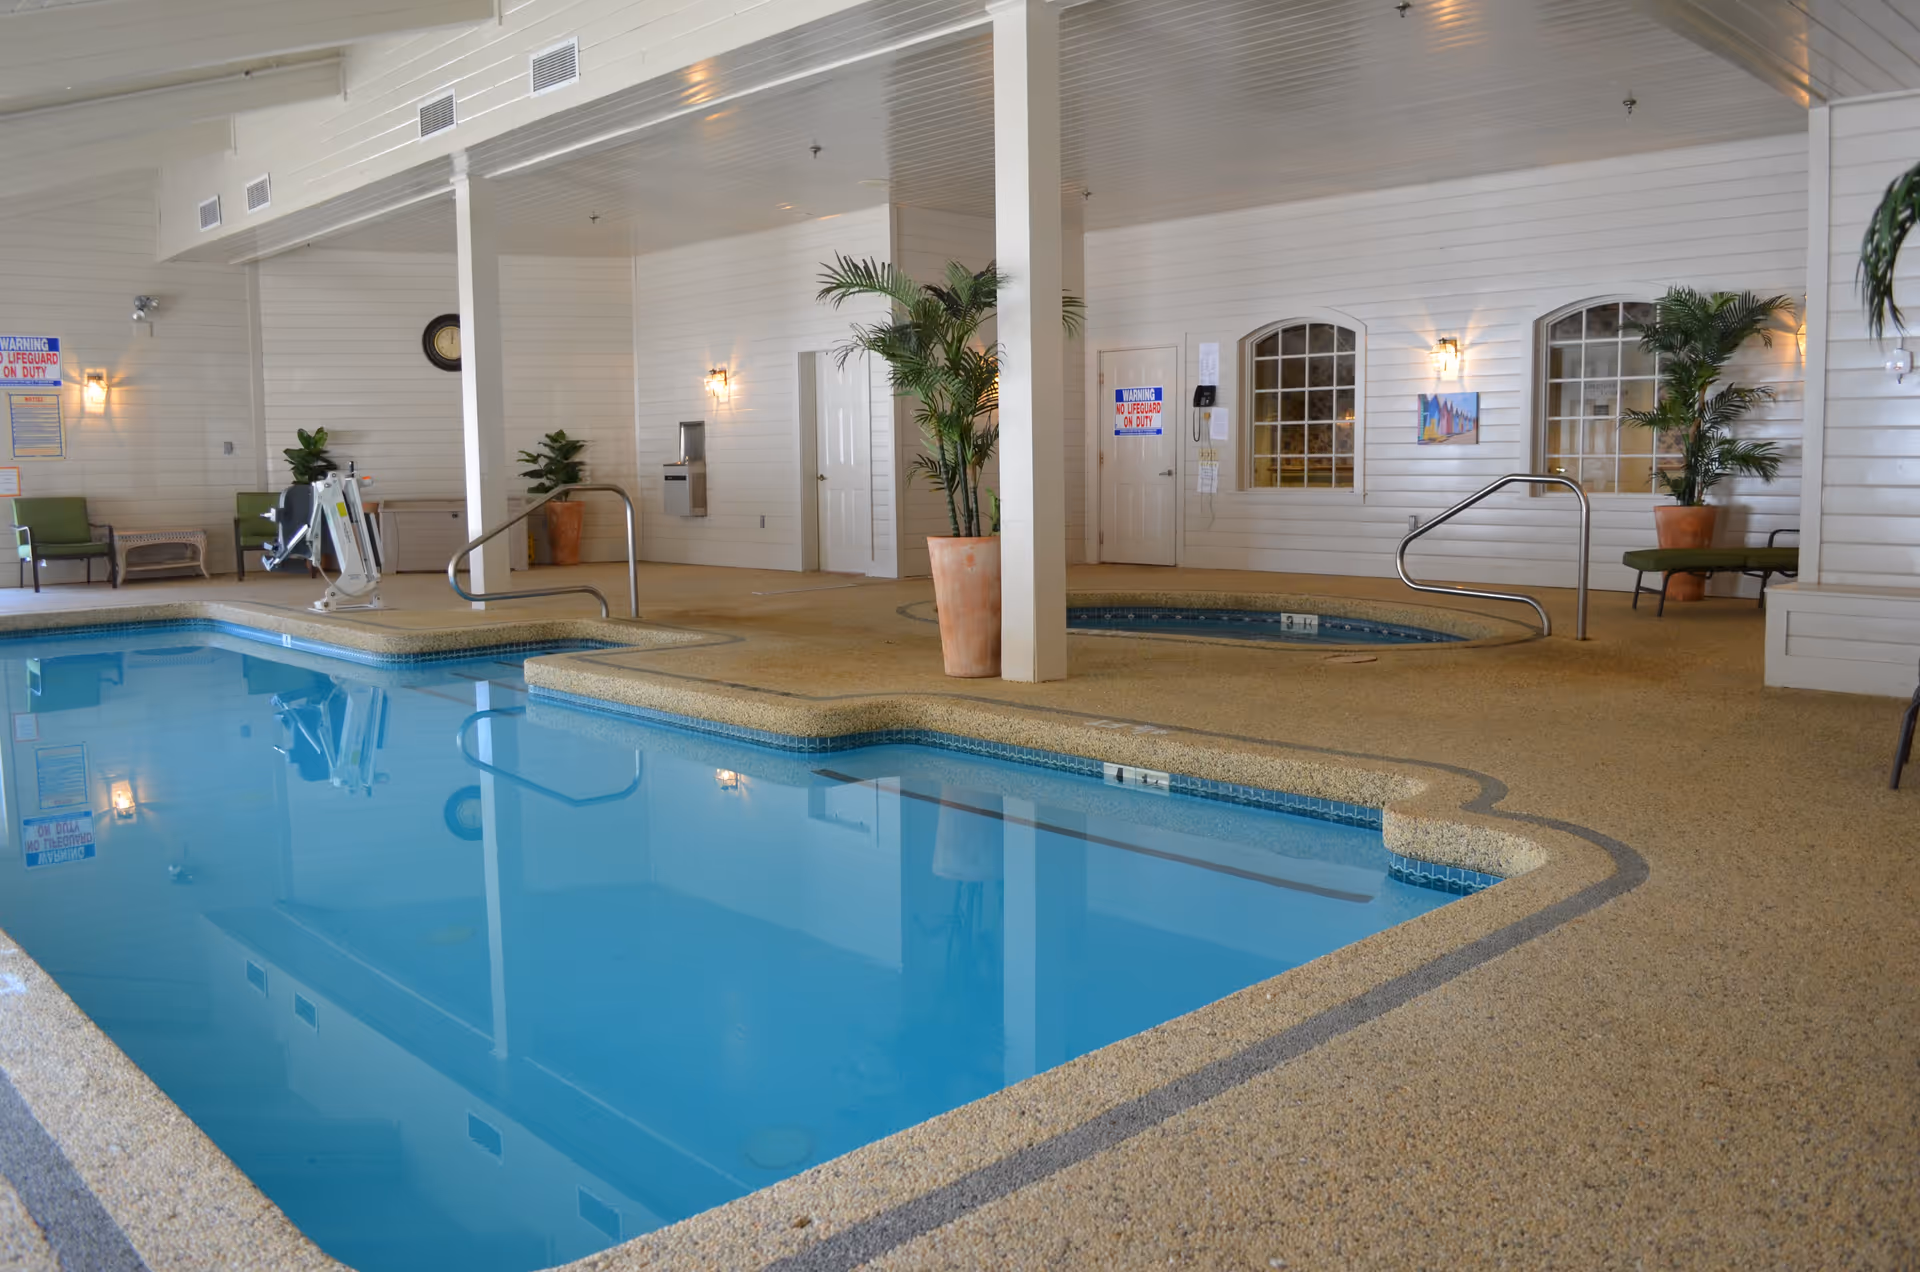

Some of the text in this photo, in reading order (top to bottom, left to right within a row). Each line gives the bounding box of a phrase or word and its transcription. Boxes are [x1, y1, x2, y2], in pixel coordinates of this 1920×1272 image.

[0, 338, 49, 351] WARNING
[8, 352, 59, 365] LIFEGUARD
[3, 365, 47, 378] ON DUTY
[1122, 388, 1156, 401] WARNING
[1116, 402, 1161, 415] NO LIFEGUARD
[1123, 415, 1153, 428] ON DUTY
